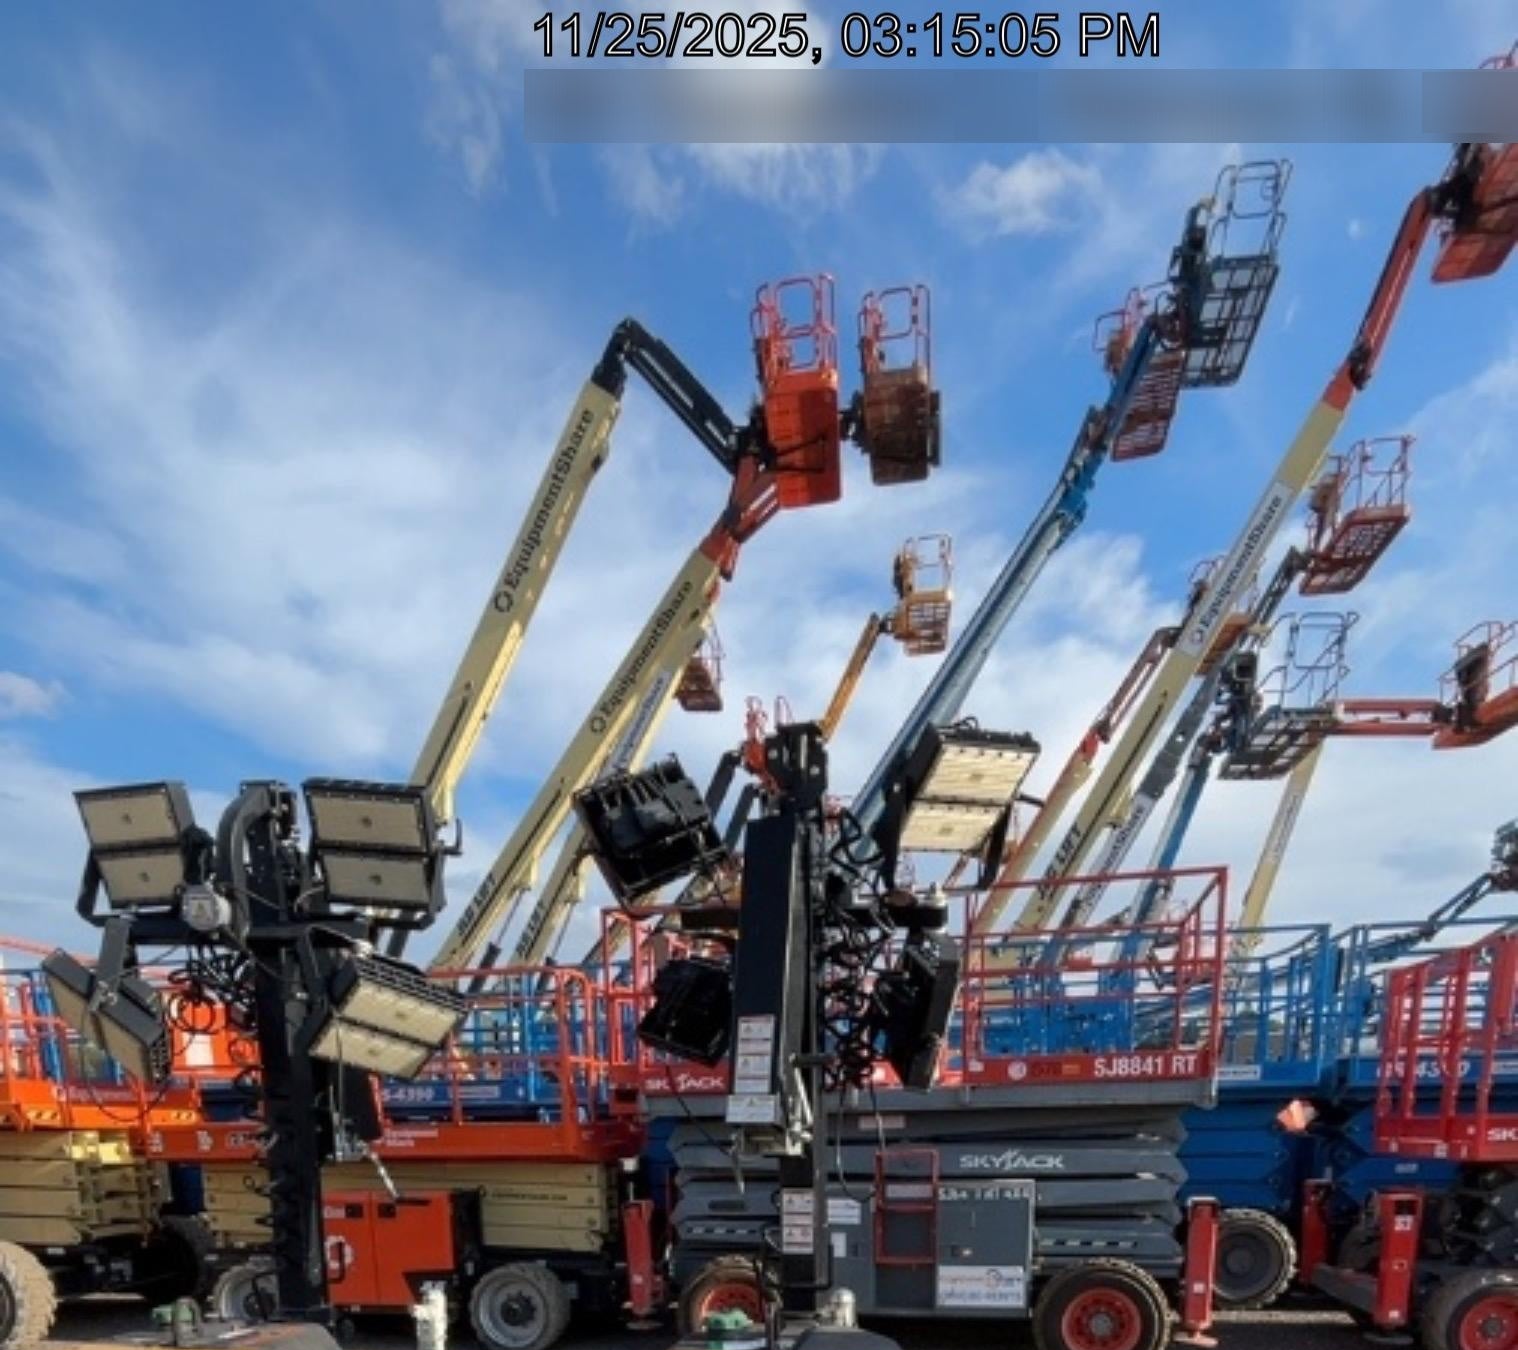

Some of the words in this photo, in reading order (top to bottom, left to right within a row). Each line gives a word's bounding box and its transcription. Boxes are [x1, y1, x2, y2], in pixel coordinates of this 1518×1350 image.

[503, 408, 596, 591] EquipmentShare
[600, 580, 693, 718] EquipmentShare
[1094, 1055, 1163, 1078] SJ8841
[1171, 1054, 1198, 1075] RT
[645, 1071, 725, 1091] SKJACK
[959, 1150, 1064, 1170] SKYJACK
